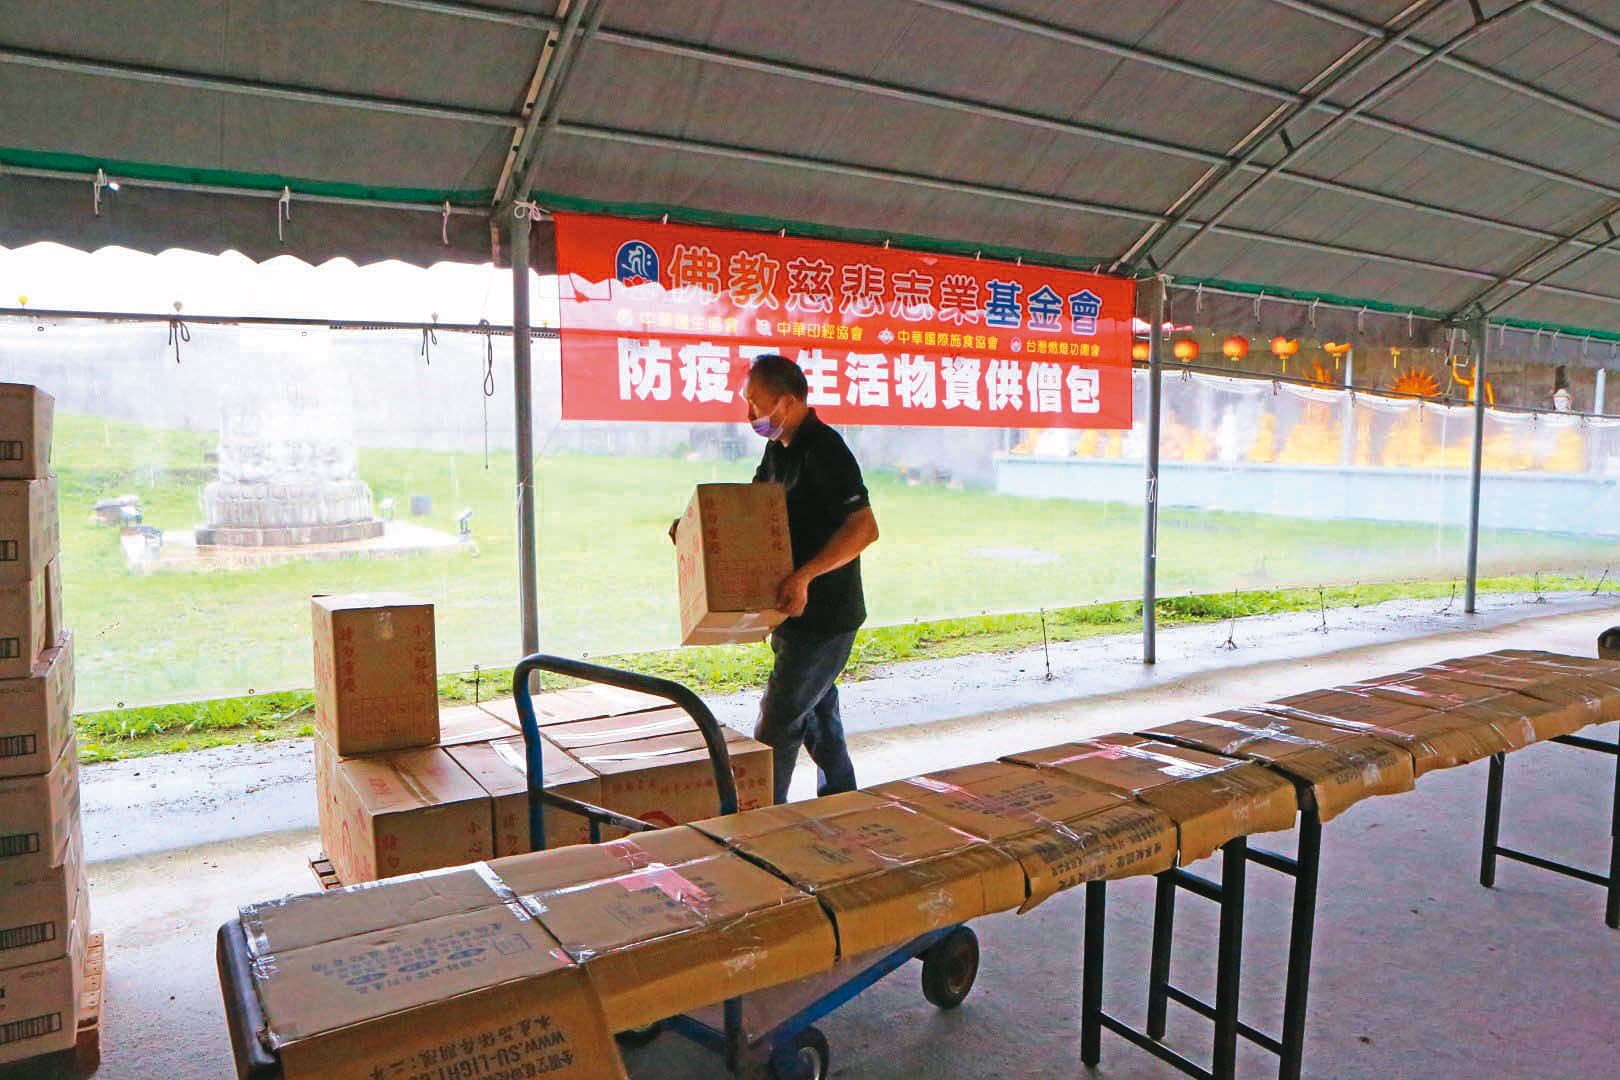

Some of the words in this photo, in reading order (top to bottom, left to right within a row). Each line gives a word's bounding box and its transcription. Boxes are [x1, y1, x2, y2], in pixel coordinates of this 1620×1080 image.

[667, 243, 1103, 336] 佛教慈悲志業基金會
